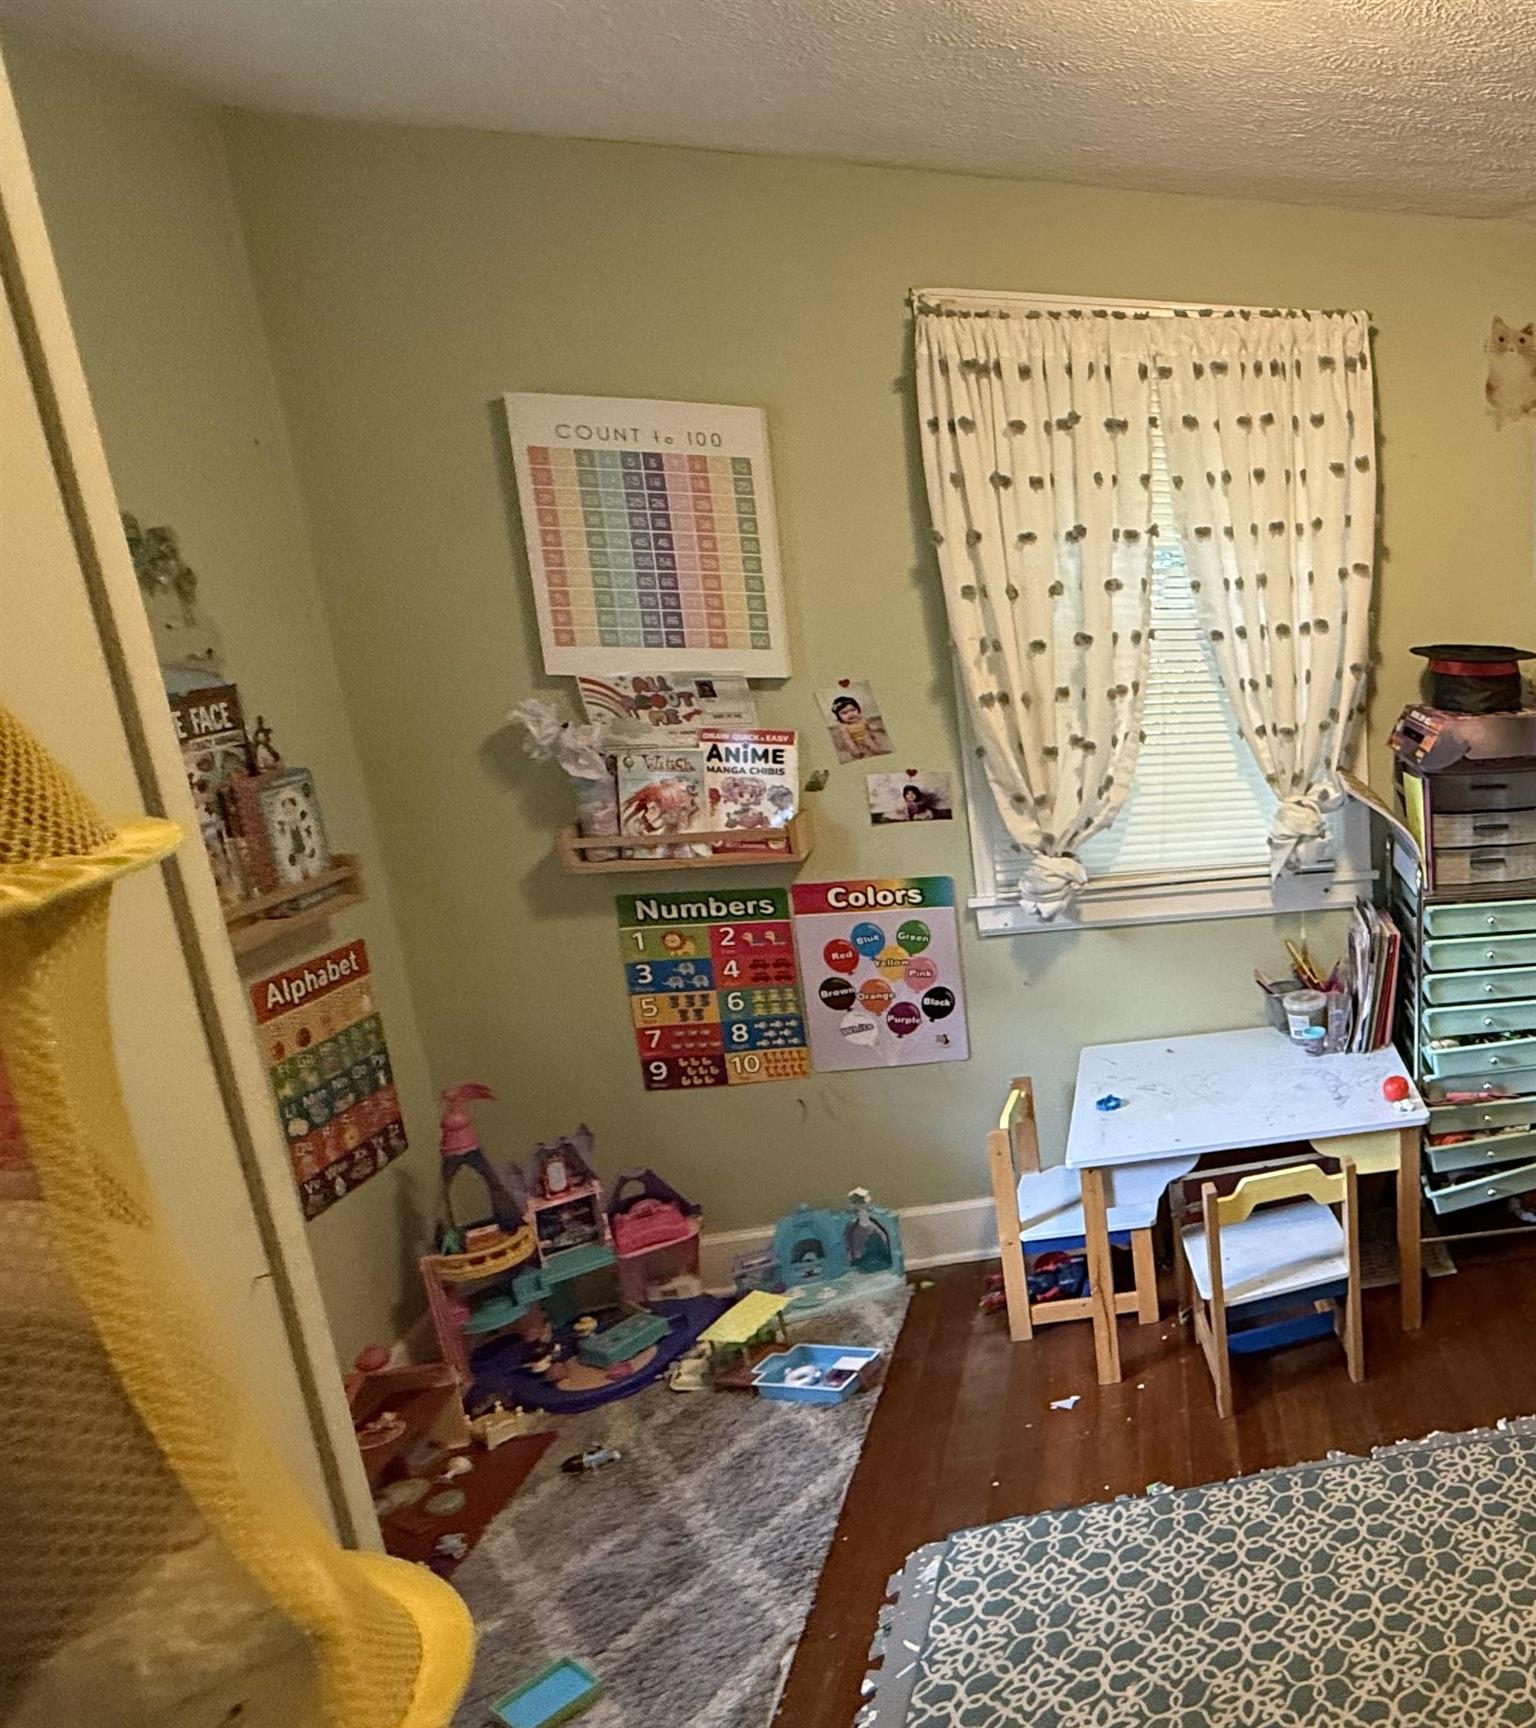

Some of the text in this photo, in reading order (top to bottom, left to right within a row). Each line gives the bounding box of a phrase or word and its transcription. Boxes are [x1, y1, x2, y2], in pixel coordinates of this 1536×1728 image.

[555, 423, 723, 448] COUNT to 100
[190, 702, 233, 728] FACE
[765, 734, 790, 742] EASY
[706, 766, 786, 776] MANGA CHIBIS
[827, 885, 923, 909] Colors
[636, 897, 776, 921] Numbers
[632, 931, 648, 950] 1
[719, 927, 736, 947] 2
[856, 934, 881, 945] Blue
[897, 931, 929, 942] Green
[831, 950, 853, 961] Red
[874, 958, 909, 968] Yellow
[636, 965, 653, 984] 3
[722, 960, 740, 978] 4
[908, 968, 932, 978] Pink
[266, 950, 359, 1010] Alphabet
[727, 992, 745, 1011] 6
[820, 987, 856, 999] Brown
[857, 992, 896, 1002] Orange
[923, 997, 951, 1007] Black
[641, 998, 658, 1017] 5
[887, 1015, 922, 1025] Purple
[730, 1023, 749, 1043] 8
[840, 1022, 875, 1037] White
[645, 1030, 661, 1048] 7
[649, 1062, 668, 1081] 9
[731, 1055, 760, 1075] 10
